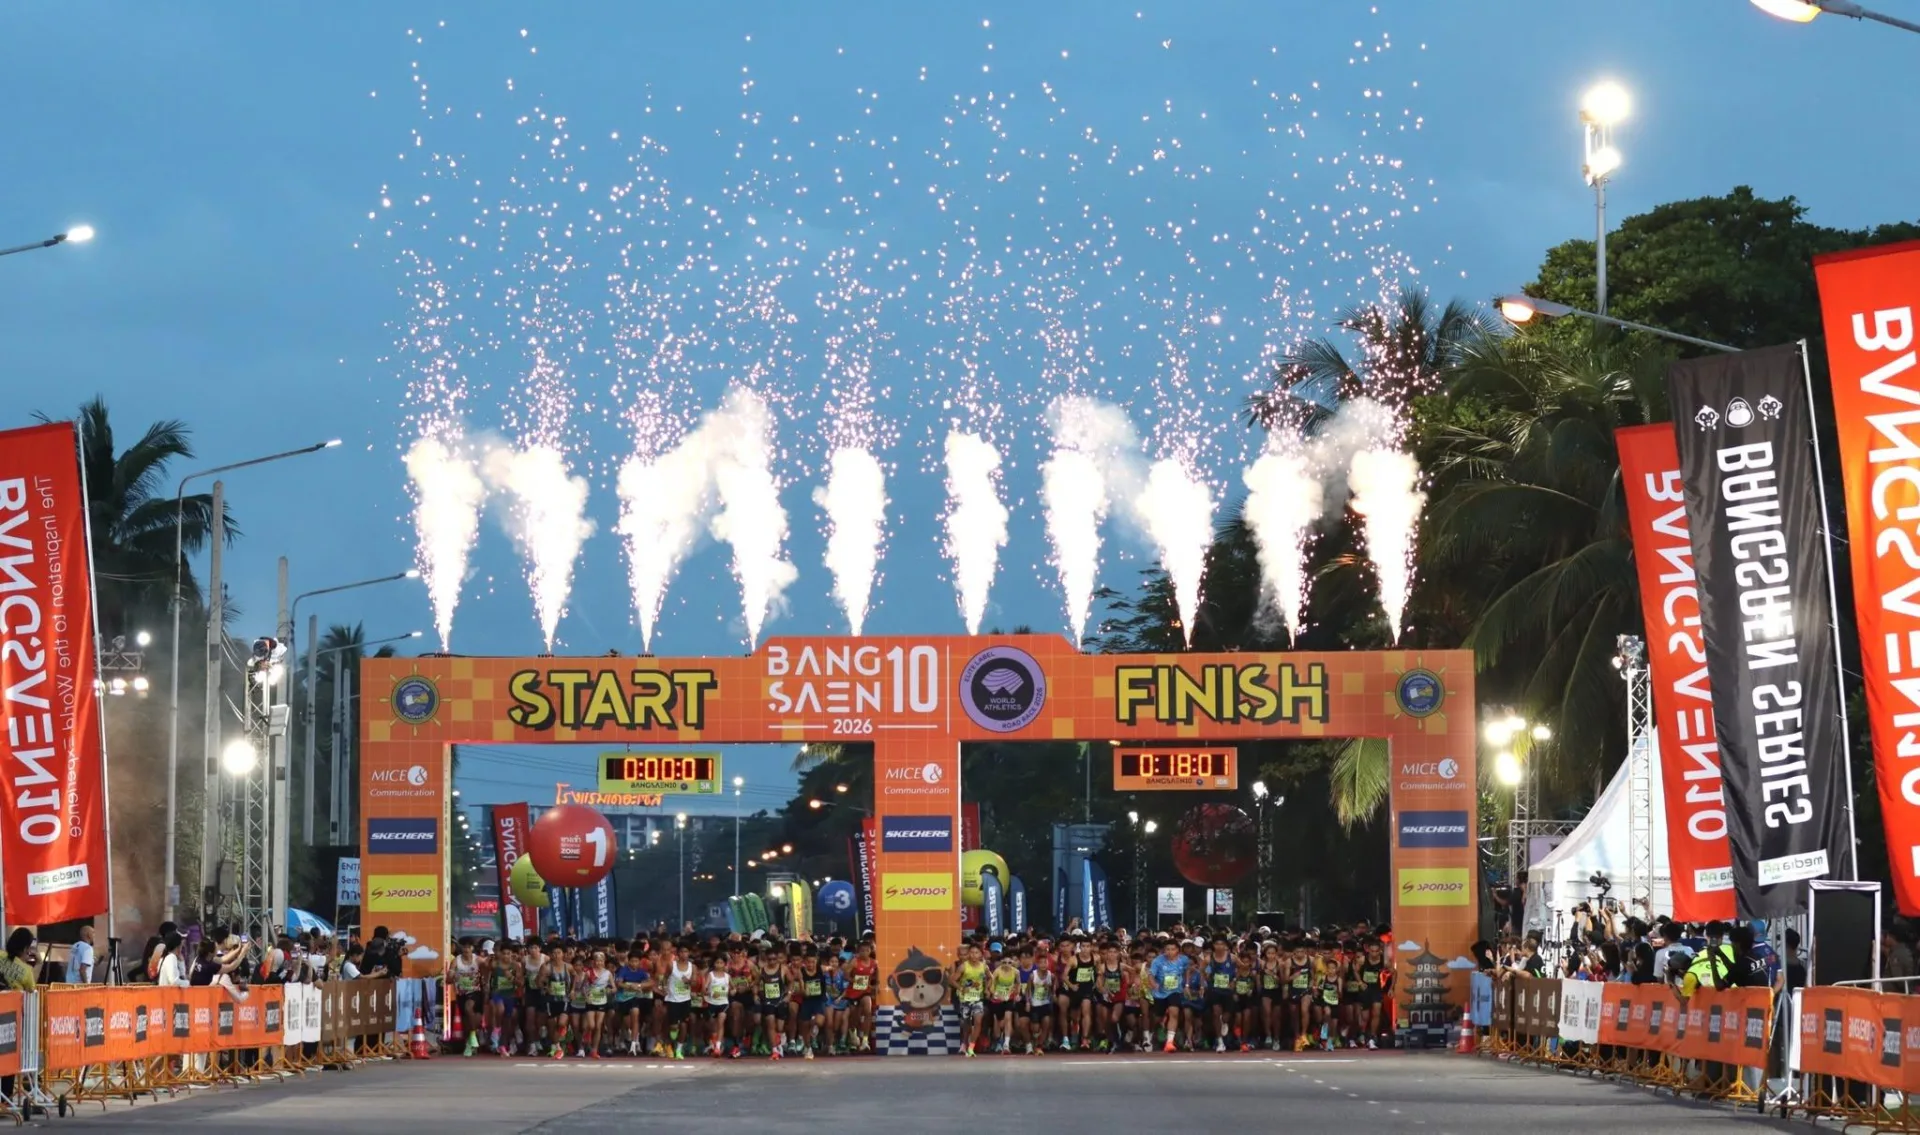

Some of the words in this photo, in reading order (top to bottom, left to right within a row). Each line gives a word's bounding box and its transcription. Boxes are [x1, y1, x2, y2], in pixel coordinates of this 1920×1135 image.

[767, 645, 881, 676] BANG
[964, 664, 976, 682] ELITE
[974, 651, 996, 667] LABEL
[886, 645, 938, 713] 10
[508, 670, 717, 730] START
[767, 681, 881, 713] SAEN
[1115, 663, 1328, 724] FINISH
[1001, 719, 1021, 729] ROAD
[1021, 707, 1037, 721] RACE
[1034, 687, 1043, 706] 2026
[832, 719, 873, 734] 2026
[624, 757, 713, 781] 0:00:01
[1140, 754, 1229, 777] 0:18:01
[1401, 763, 1438, 775] MICE
[371, 769, 408, 782] MICE
[885, 767, 922, 780] MICE
[370, 787, 435, 797] Communication
[884, 786, 950, 796] Communication
[1400, 781, 1466, 791] Communication
[370, 831, 434, 840] SKECHERS
[885, 829, 949, 838] SKECHERS
[1402, 825, 1465, 834] SKECHERS
[585, 827, 607, 867] 1
[385, 888, 432, 898] SPONSOR
[900, 887, 947, 896] SPONSOR
[1417, 882, 1464, 892] SPONSOR
[834, 889, 851, 910] 3
